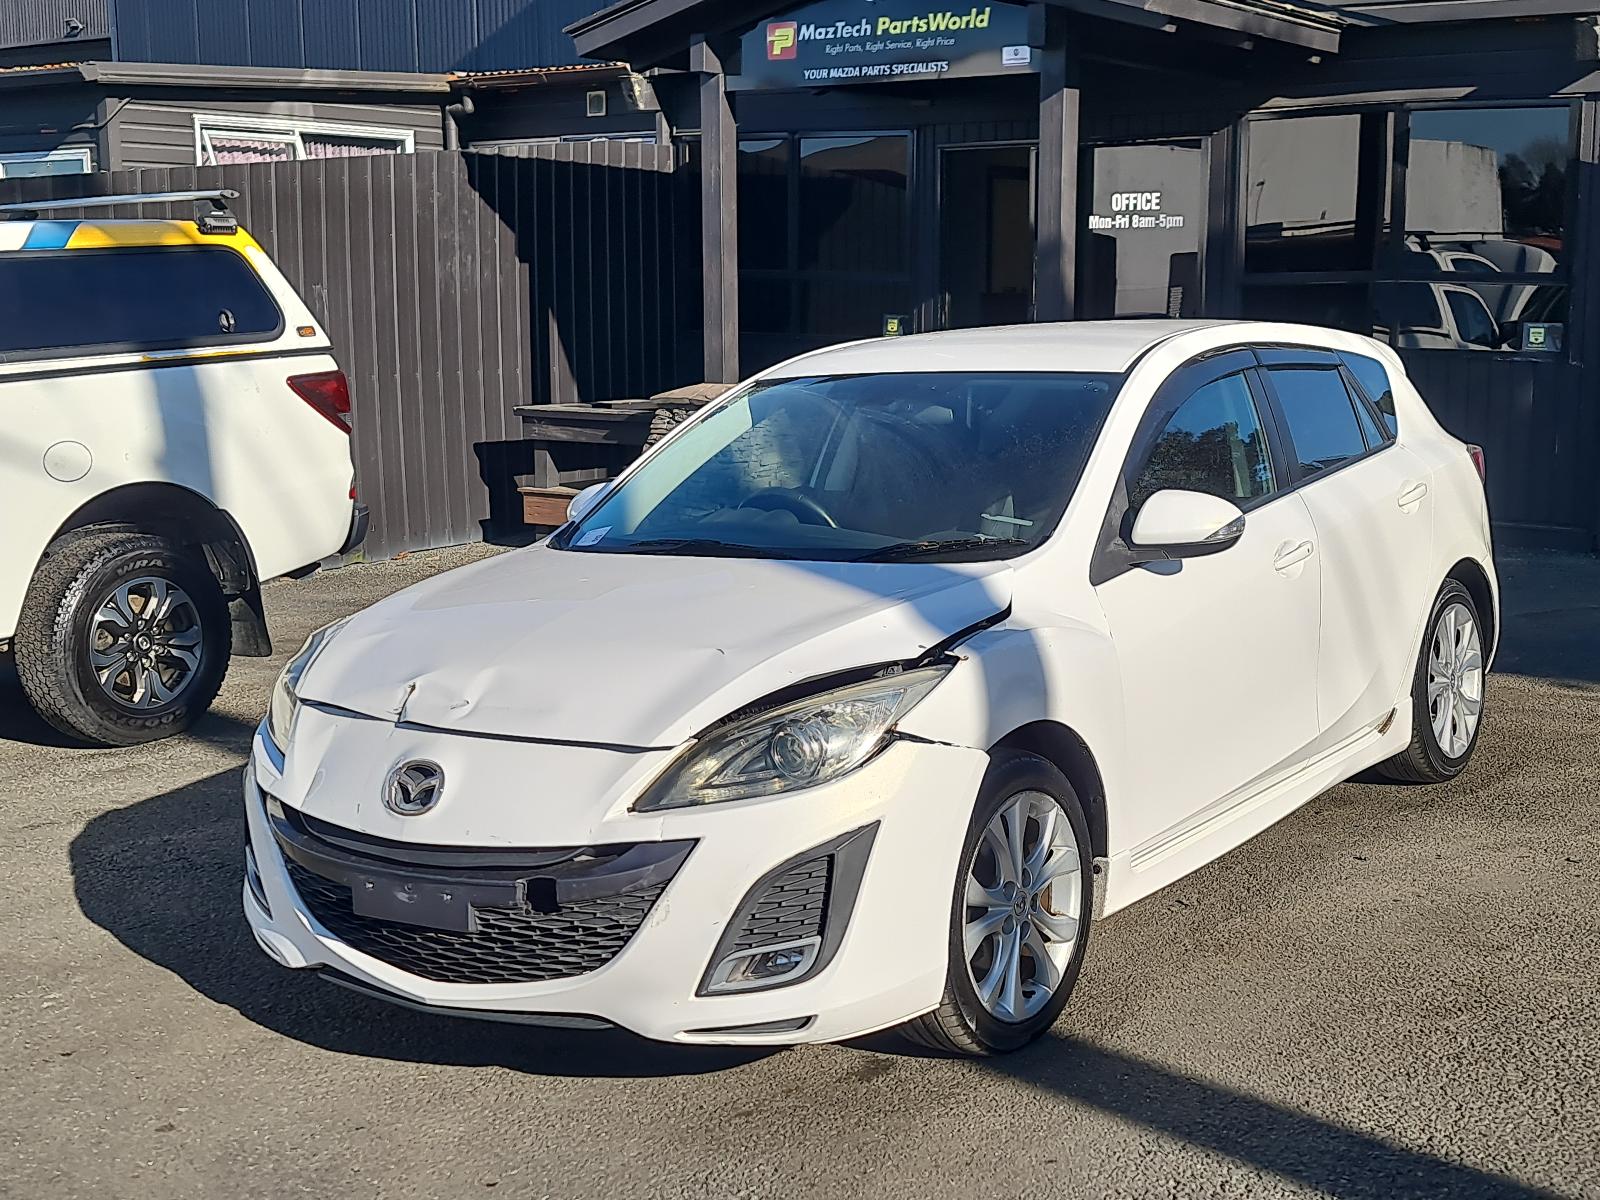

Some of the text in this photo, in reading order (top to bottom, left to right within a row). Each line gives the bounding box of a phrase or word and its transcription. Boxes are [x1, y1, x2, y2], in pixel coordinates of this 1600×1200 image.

[798, 6, 991, 41] MazTech PartsWorld
[825, 36, 955, 56] Right Parts, Right Service, Right Price
[803, 61, 949, 80] YOUR MAZDA PARTS SPECIALISTS
[1111, 193, 1160, 212] OFFICE
[1088, 213, 1184, 230] Mon-Fri 8am-5pm
